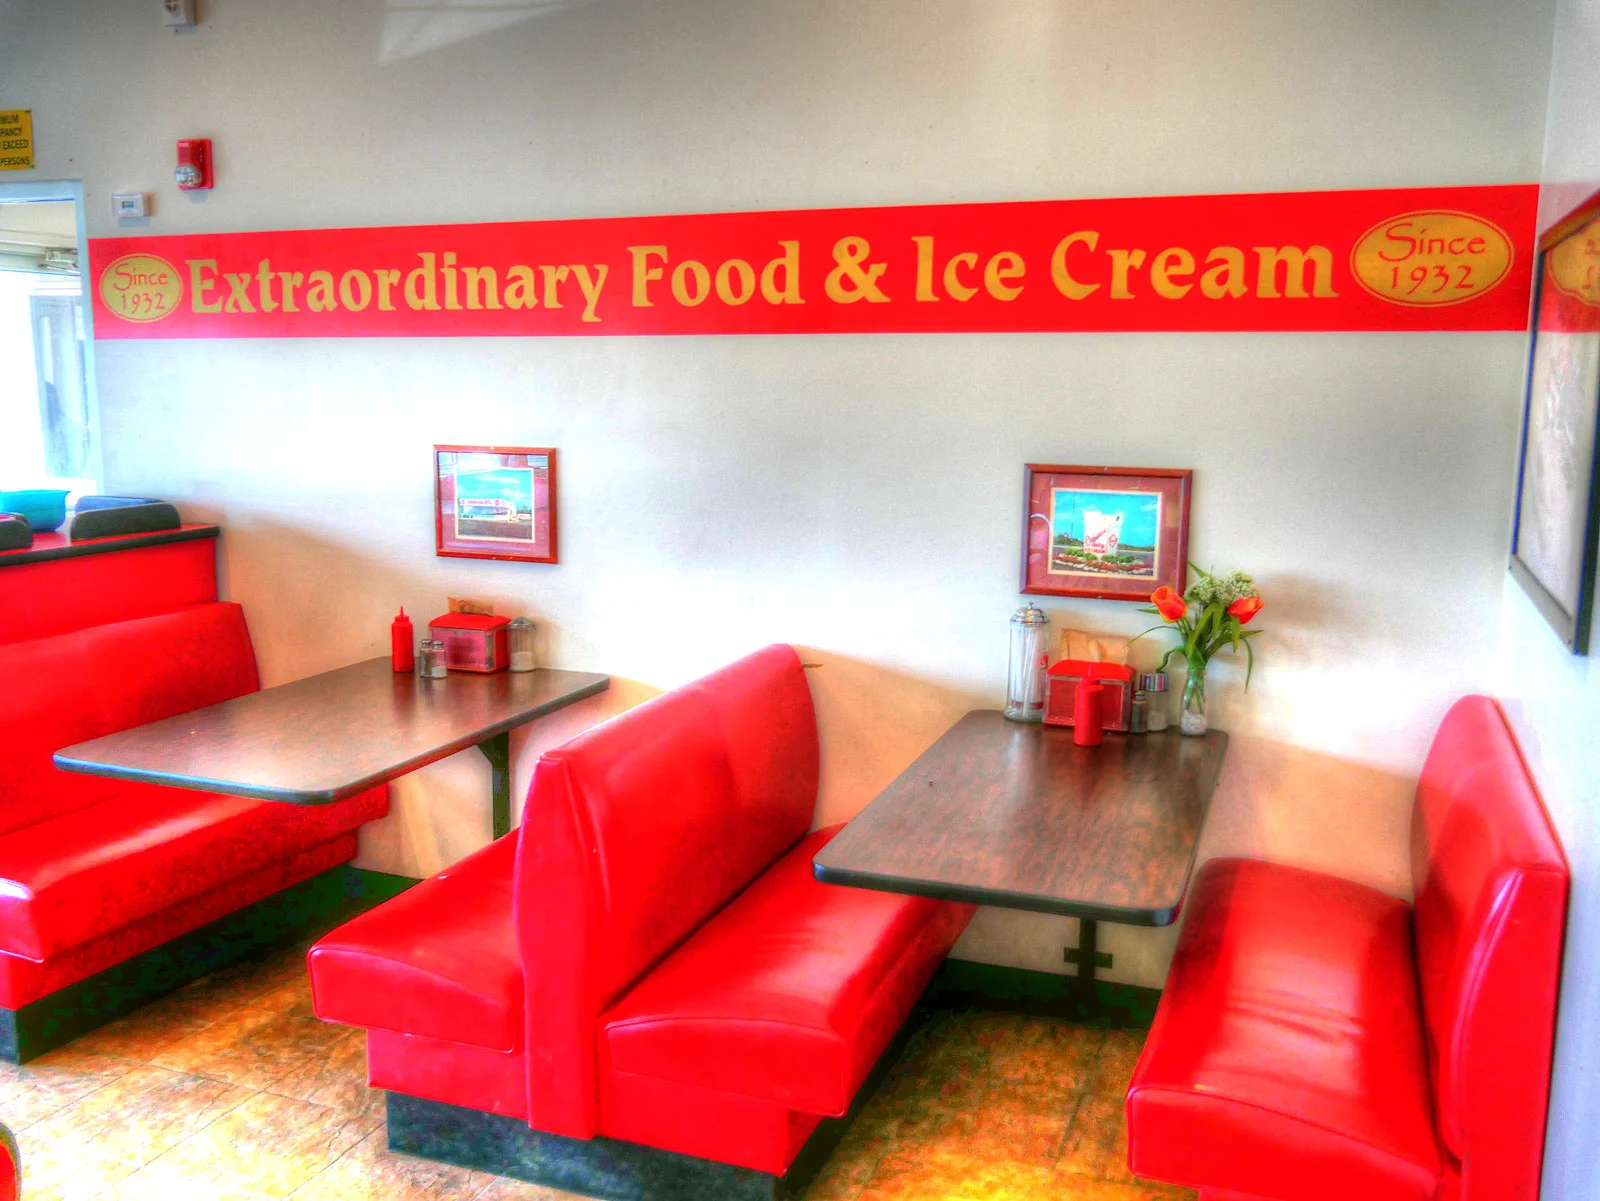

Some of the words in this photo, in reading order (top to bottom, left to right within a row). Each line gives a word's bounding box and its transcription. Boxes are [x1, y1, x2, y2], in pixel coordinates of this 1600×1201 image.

[2, 139, 29, 149] EXCEED
[1378, 222, 1486, 262] Since
[113, 262, 168, 291] Since
[186, 251, 609, 323] Extraordinary
[627, 240, 805, 308] Food
[825, 236, 891, 304] &
[912, 235, 1026, 303] Ice
[1052, 230, 1339, 301] Cream
[1391, 264, 1474, 295] 1932
[121, 291, 165, 314] 1932
